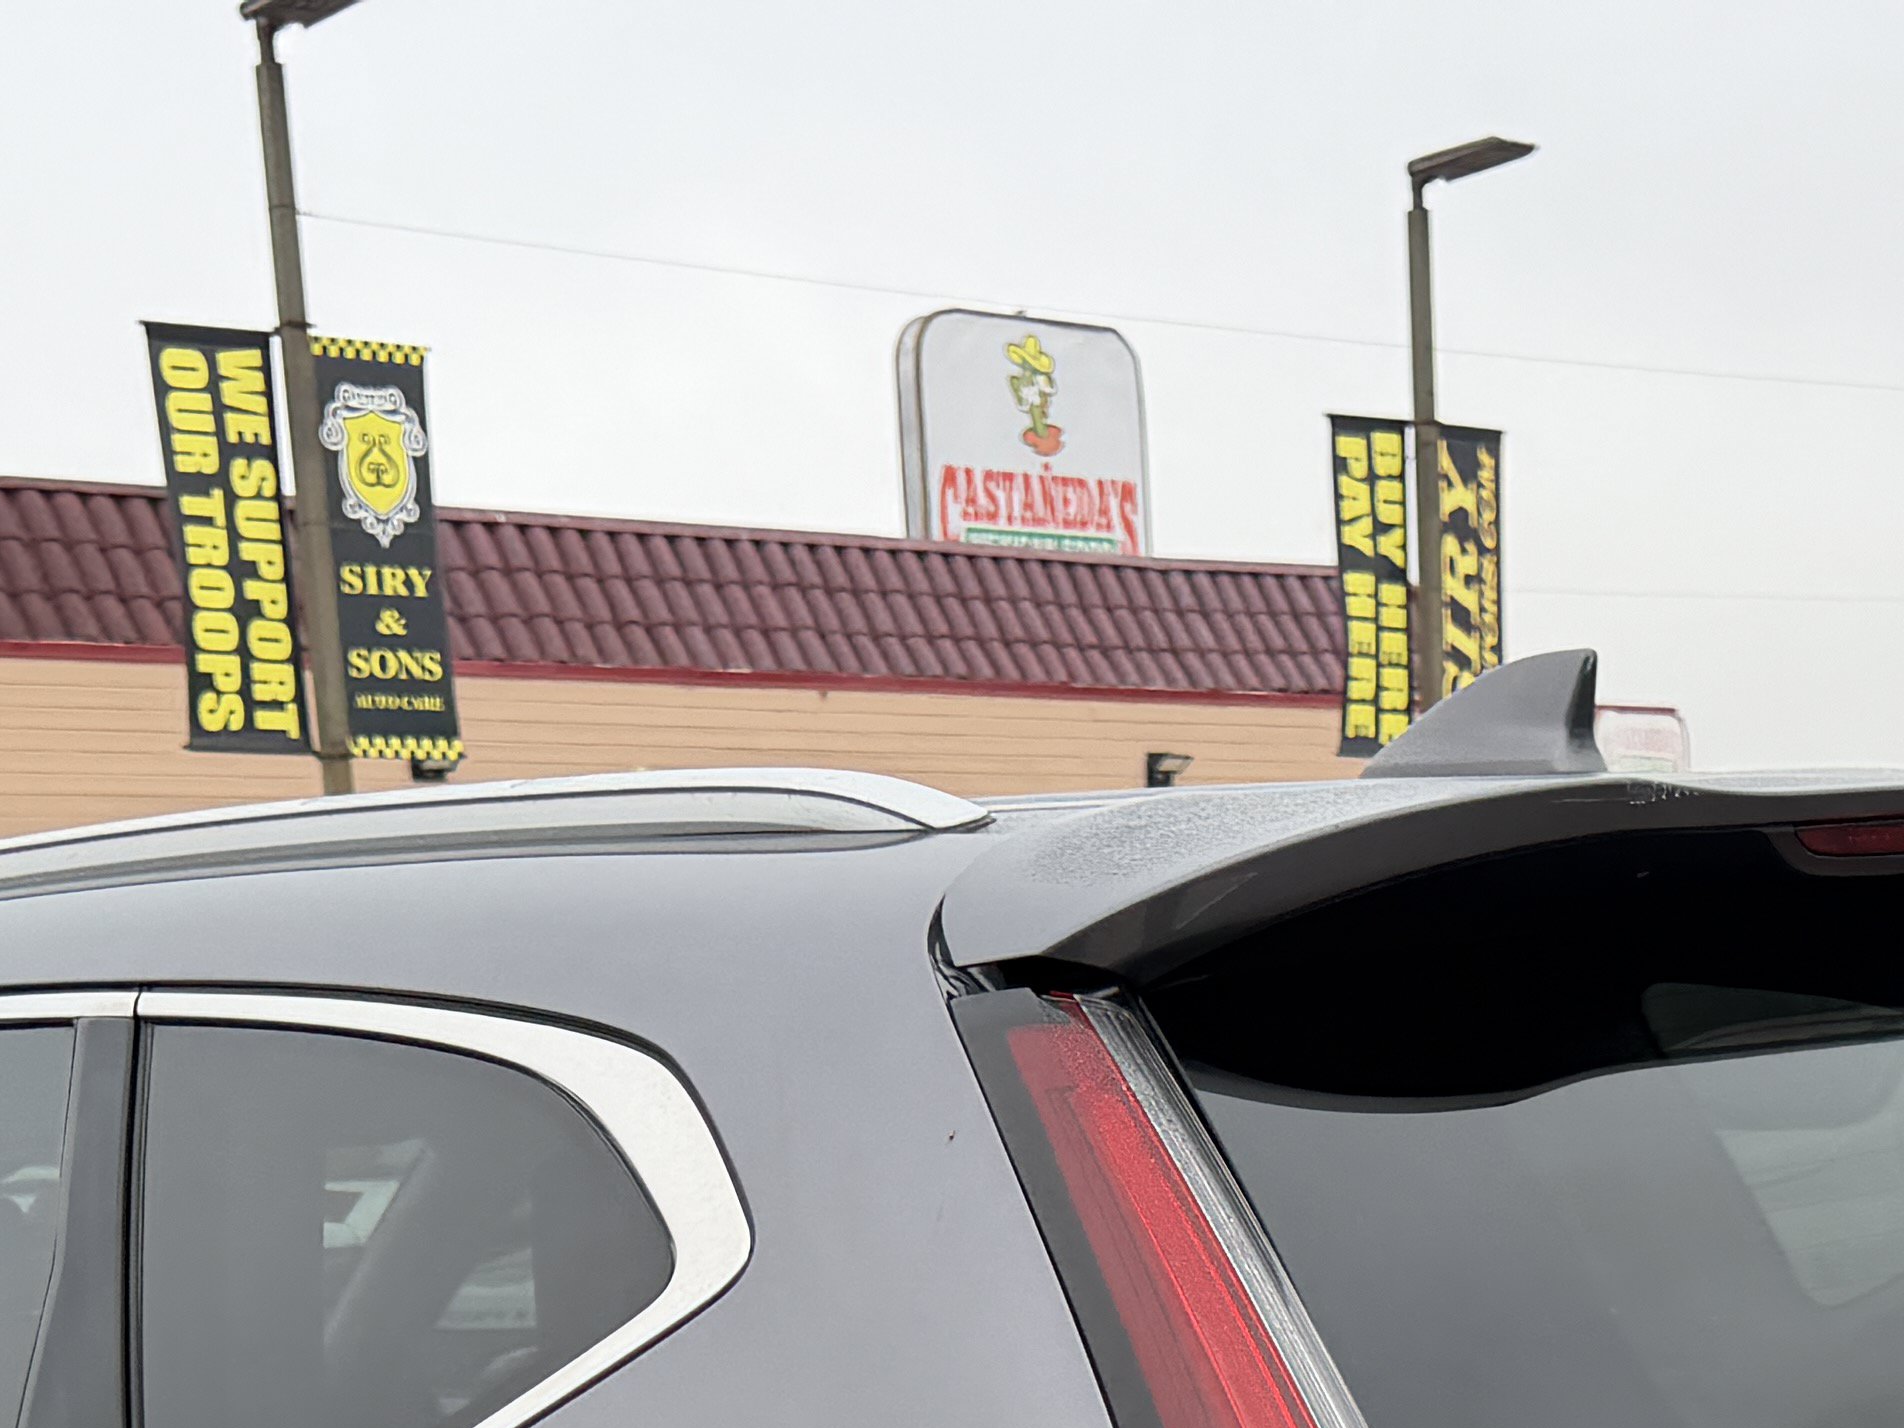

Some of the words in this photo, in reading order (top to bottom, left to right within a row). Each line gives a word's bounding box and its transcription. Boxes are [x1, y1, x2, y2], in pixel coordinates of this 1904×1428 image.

[159, 347, 219, 475] OUR
[216, 348, 272, 446] WE
[1336, 435, 1374, 557] PAY
[1371, 431, 1405, 569] BUY
[179, 488, 245, 733] TROOPS
[229, 458, 299, 740] SUPPORT
[340, 562, 432, 598] SIRY
[375, 608, 408, 636] &
[347, 648, 443, 682] SONS
[1343, 571, 1376, 739] HERE
[1378, 583, 1409, 745] HERE
